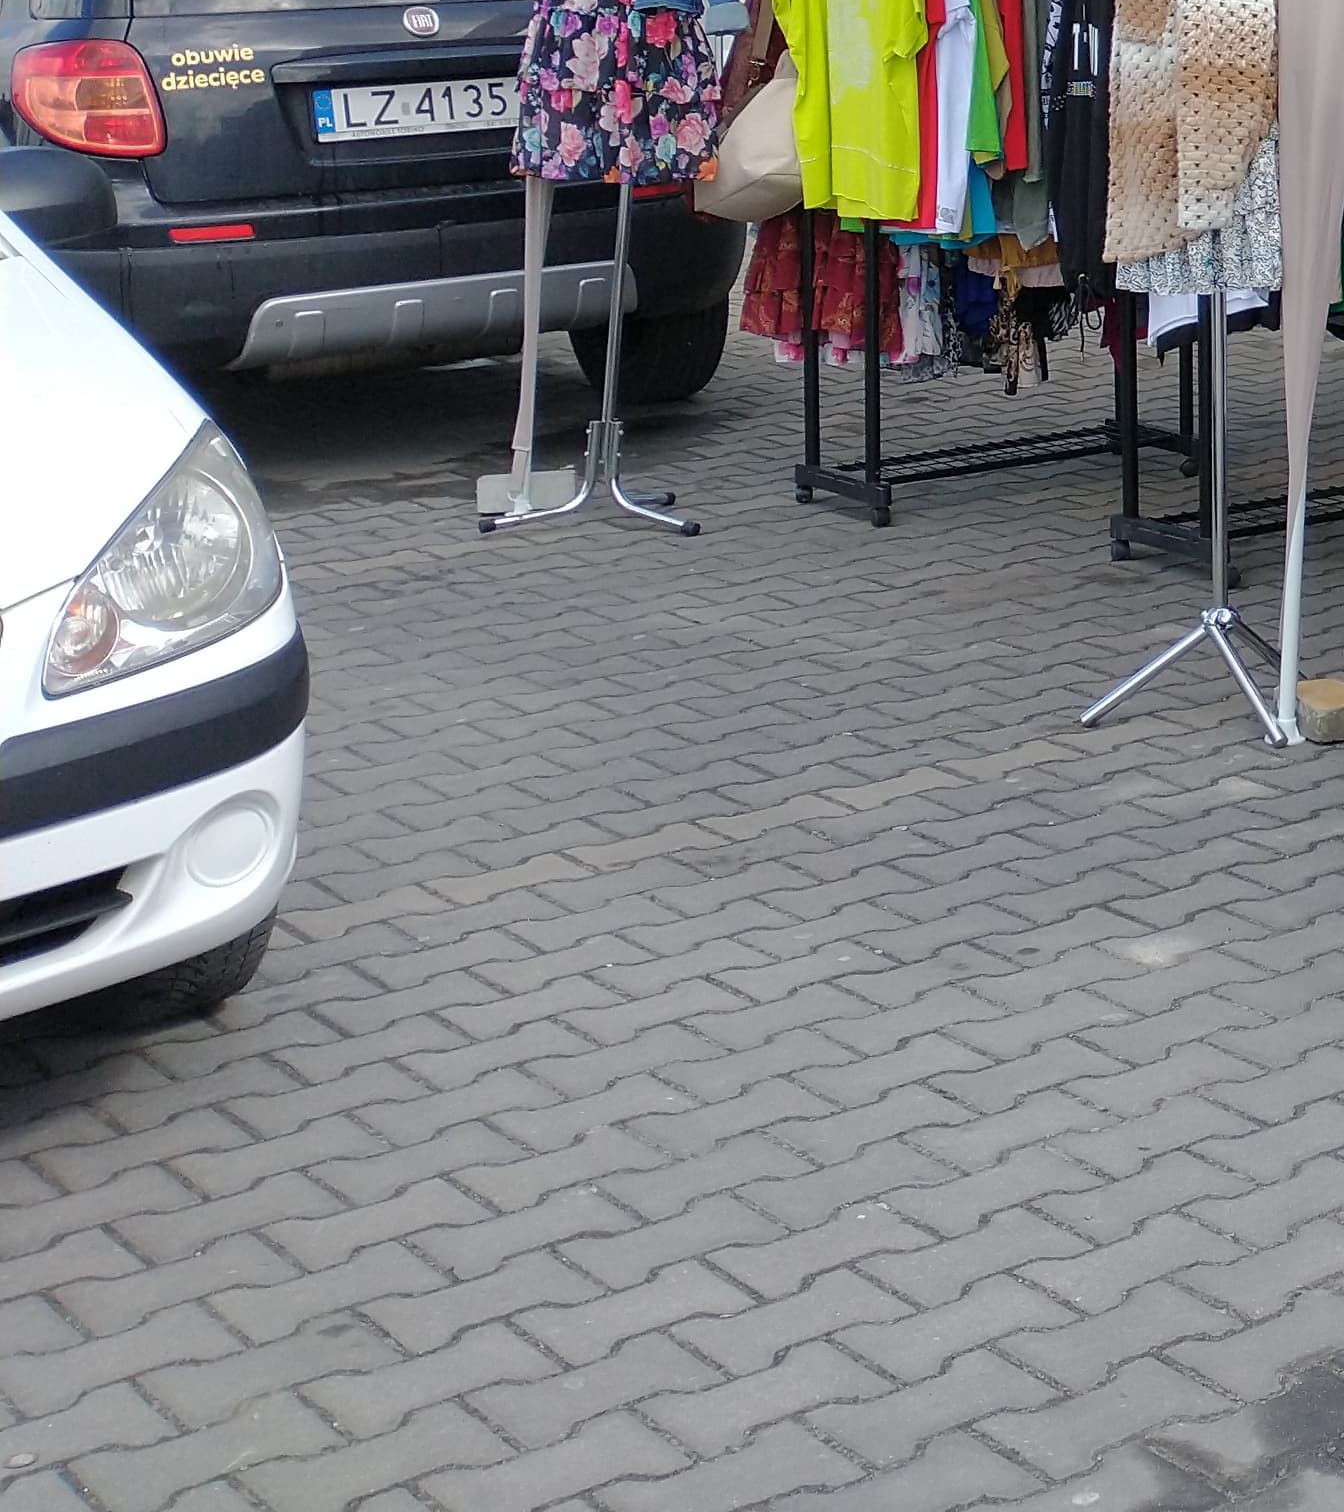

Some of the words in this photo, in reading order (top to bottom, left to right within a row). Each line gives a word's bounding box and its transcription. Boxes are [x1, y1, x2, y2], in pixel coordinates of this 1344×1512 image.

[411, 14, 434, 29] FIAT
[171, 43, 254, 67] obuwie
[161, 67, 265, 92] dziecięce
[342, 89, 399, 129] LZ
[415, 81, 520, 123] 4135
[318, 117, 334, 128] PL
